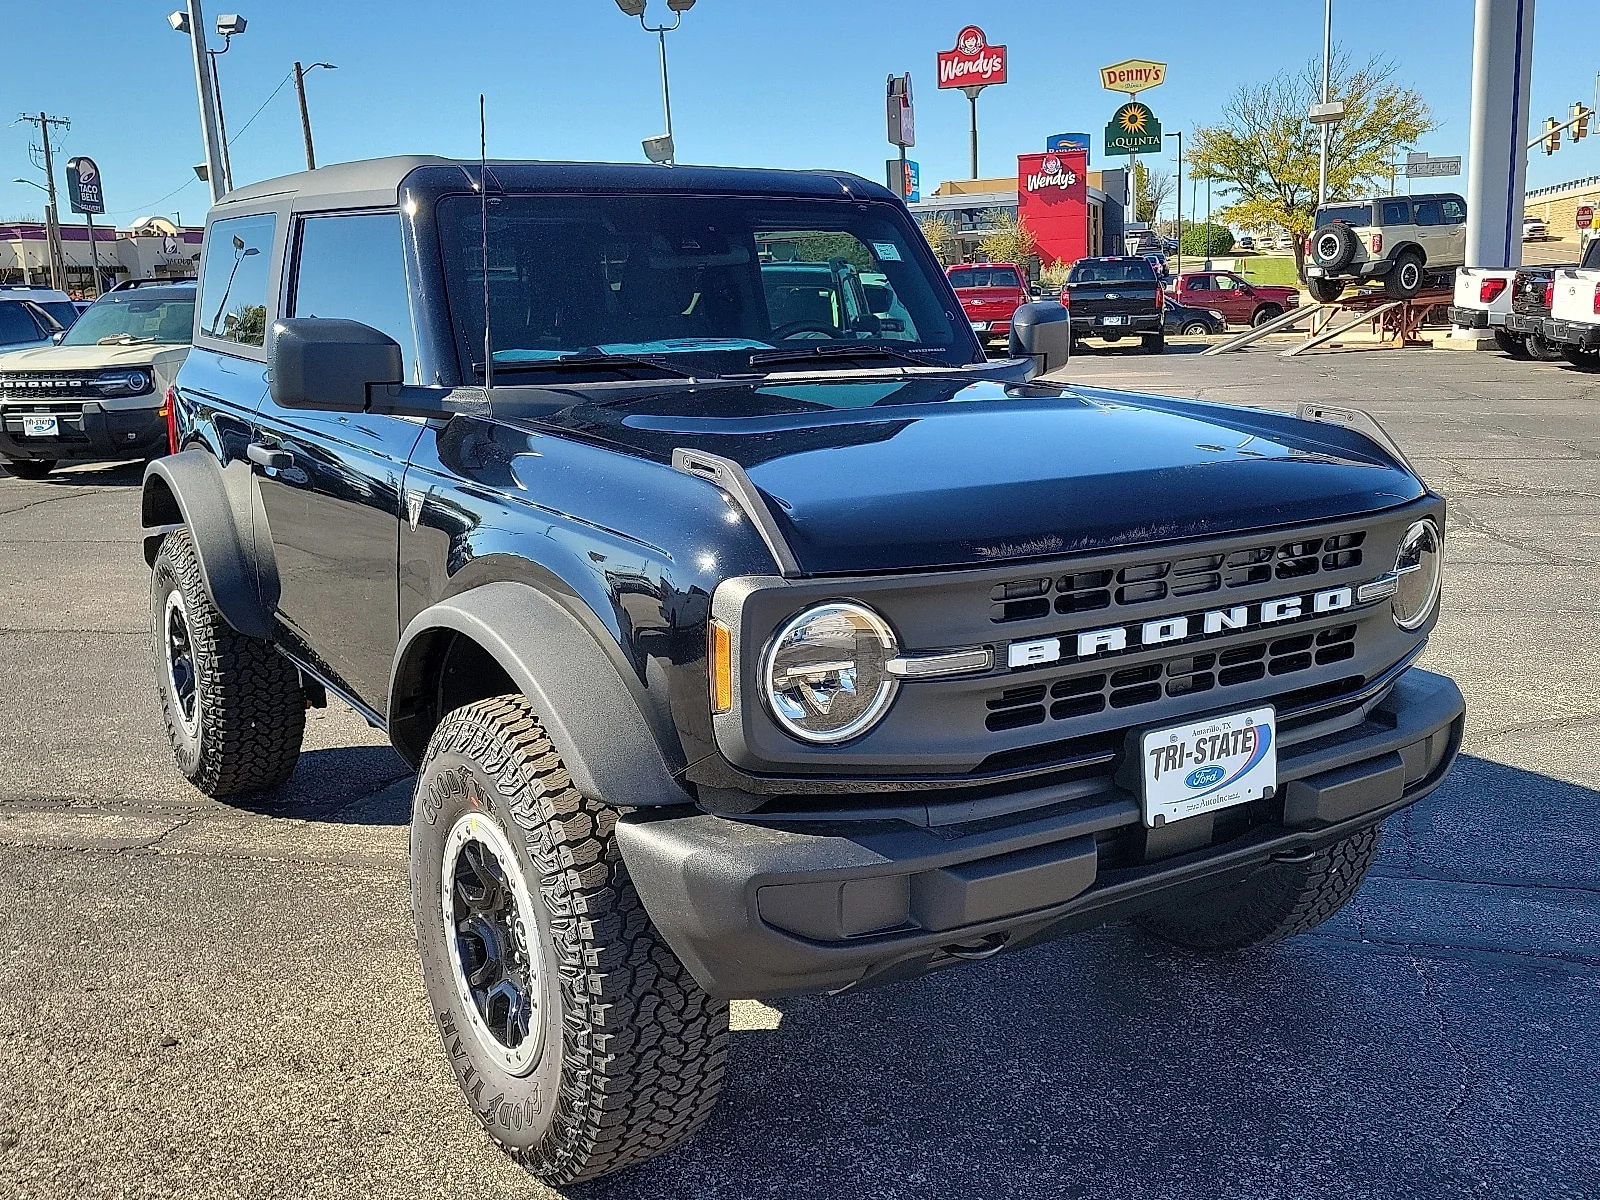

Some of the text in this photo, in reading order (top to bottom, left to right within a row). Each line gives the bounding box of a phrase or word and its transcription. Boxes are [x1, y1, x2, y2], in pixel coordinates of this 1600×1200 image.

[940, 50, 1003, 83] Wendy's
[1106, 66, 1161, 85] Denny's
[1115, 136, 1160, 149] QUINTA
[79, 184, 98, 194] TACO
[1027, 168, 1077, 192] Wendy's
[81, 193, 99, 202] BELL
[1008, 587, 1352, 668] BRONCO
[1221, 722, 1232, 730] TX
[1149, 727, 1255, 782] TRI-STATE
[1192, 767, 1218, 786] Ford
